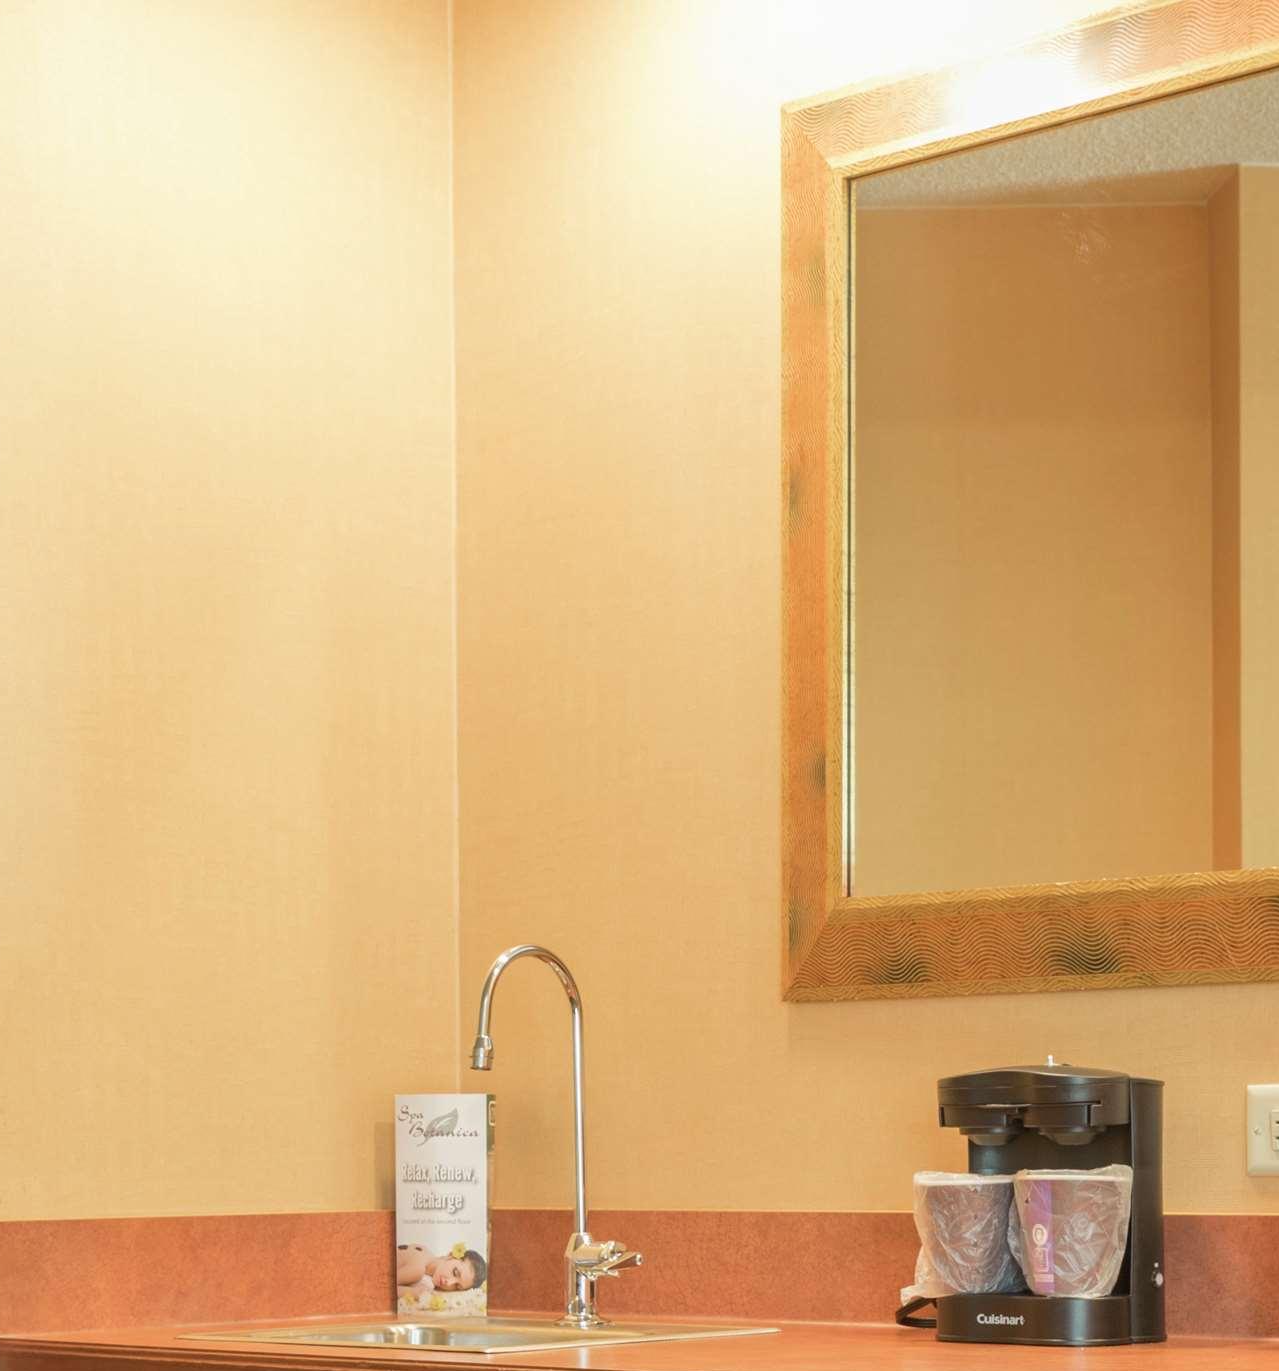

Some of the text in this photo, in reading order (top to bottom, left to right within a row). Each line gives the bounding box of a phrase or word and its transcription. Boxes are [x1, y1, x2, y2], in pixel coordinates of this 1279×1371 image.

[397, 1104, 424, 1124] Spa
[409, 1121, 479, 1138] Botanica
[400, 1162, 479, 1186] Relax, Renew,
[412, 1189, 465, 1215] Recharge
[976, 1313, 1025, 1326] Cuisinart
